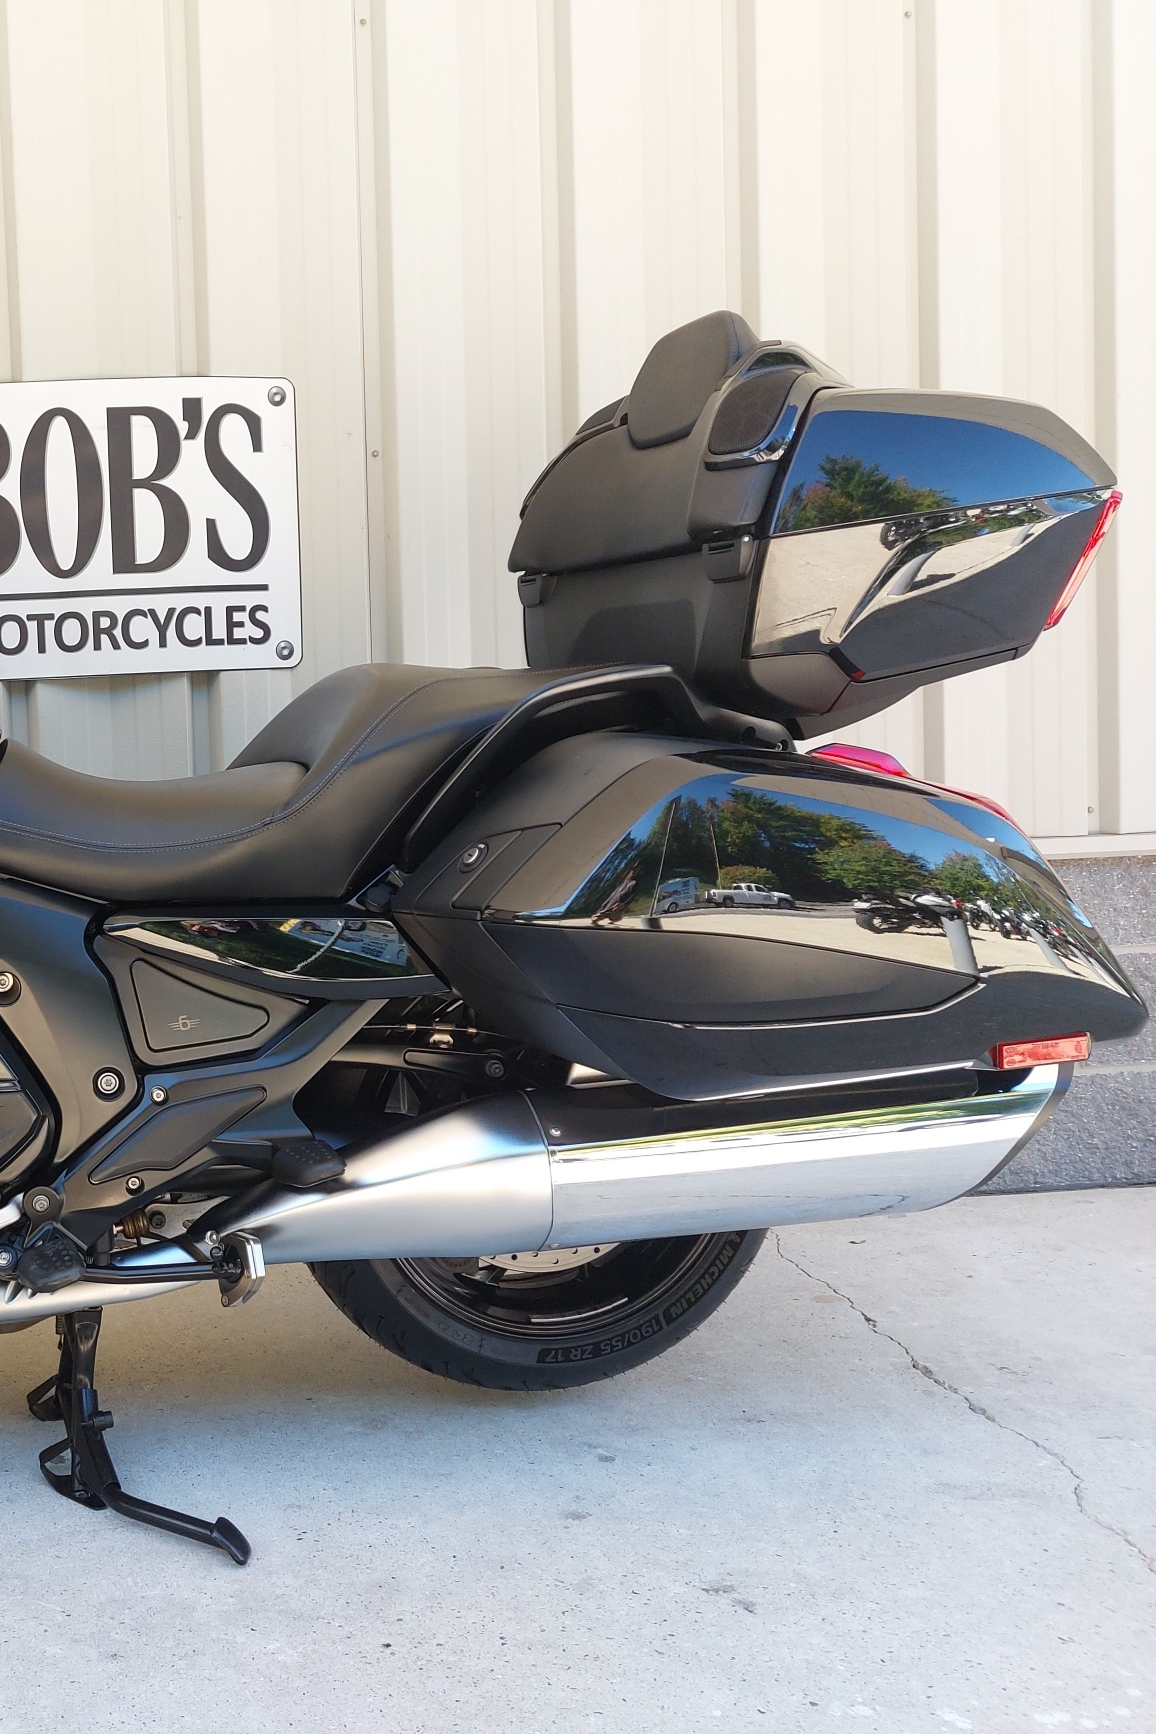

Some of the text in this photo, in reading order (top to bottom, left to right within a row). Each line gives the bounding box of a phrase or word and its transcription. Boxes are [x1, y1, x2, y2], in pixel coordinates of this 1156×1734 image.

[670, 1245, 735, 1319] MICHELIN
[600, 1317, 660, 1355] 190/55
[546, 1350, 565, 1362] 17
[570, 1349, 594, 1361] ZR
